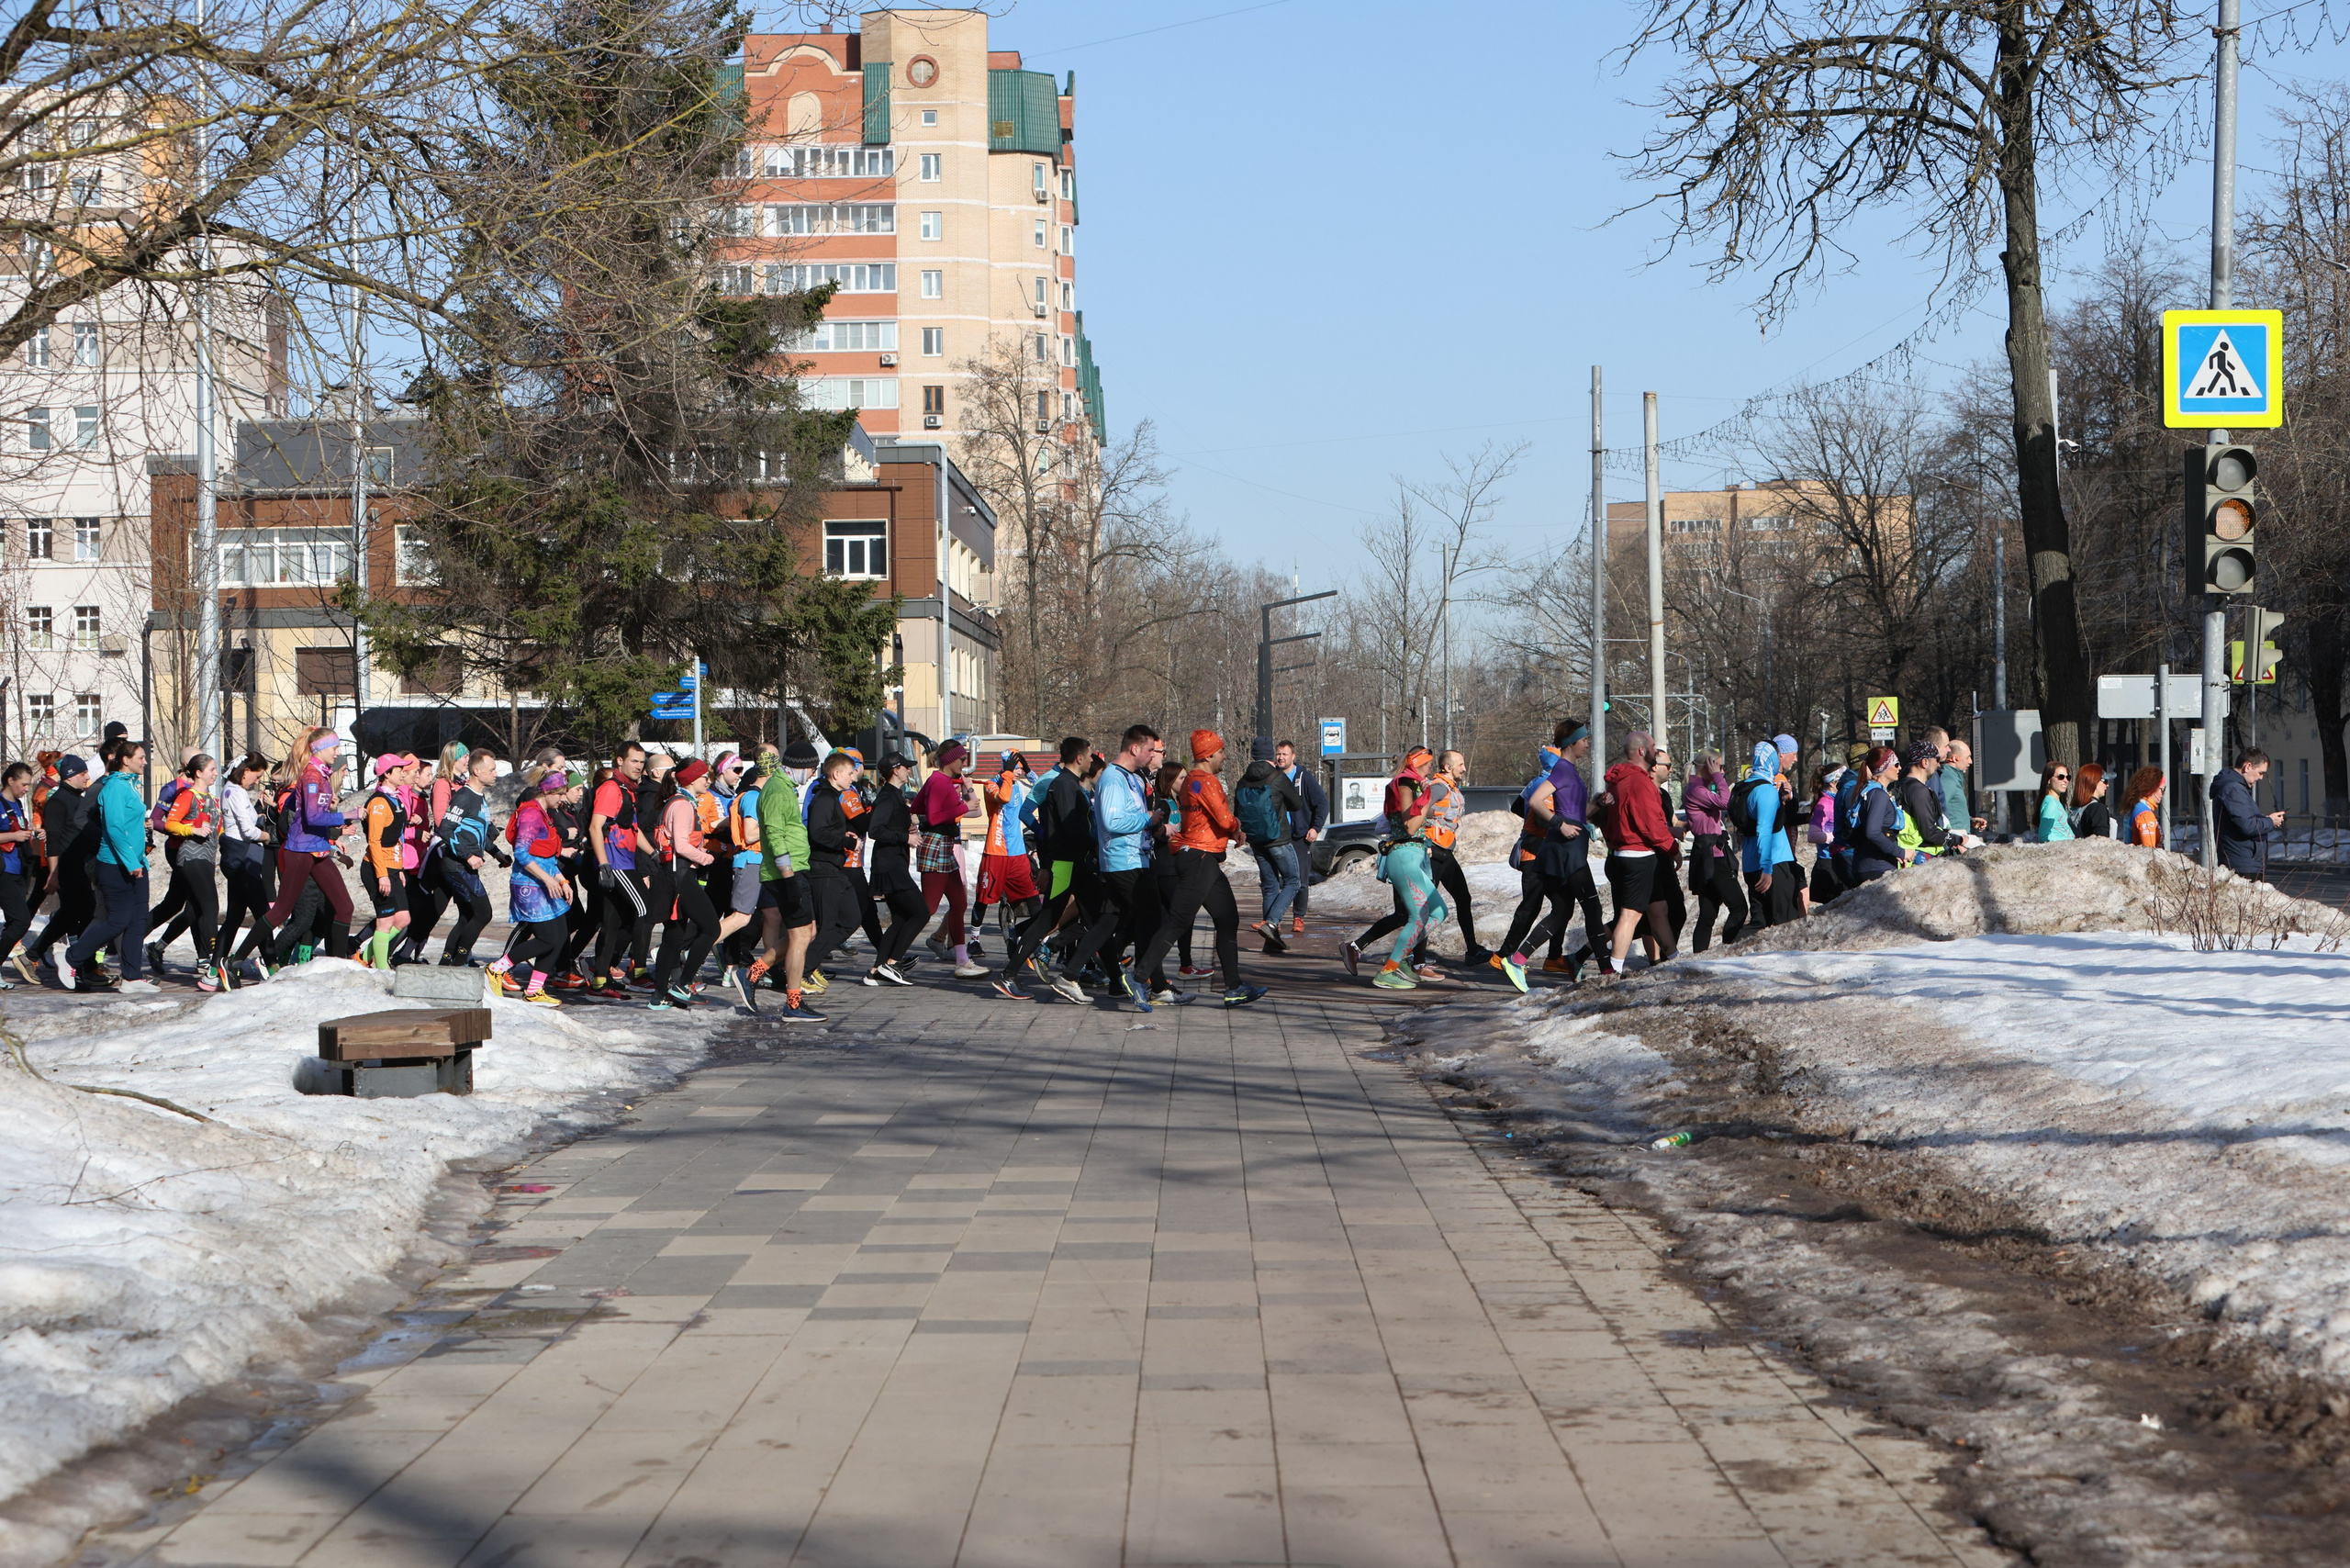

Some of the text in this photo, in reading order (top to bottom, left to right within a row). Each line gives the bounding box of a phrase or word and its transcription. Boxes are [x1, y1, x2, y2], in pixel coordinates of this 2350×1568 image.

[451, 805, 464, 816] ALP
[714, 796, 725, 819] PELIN
[994, 826, 1002, 846] RUN
